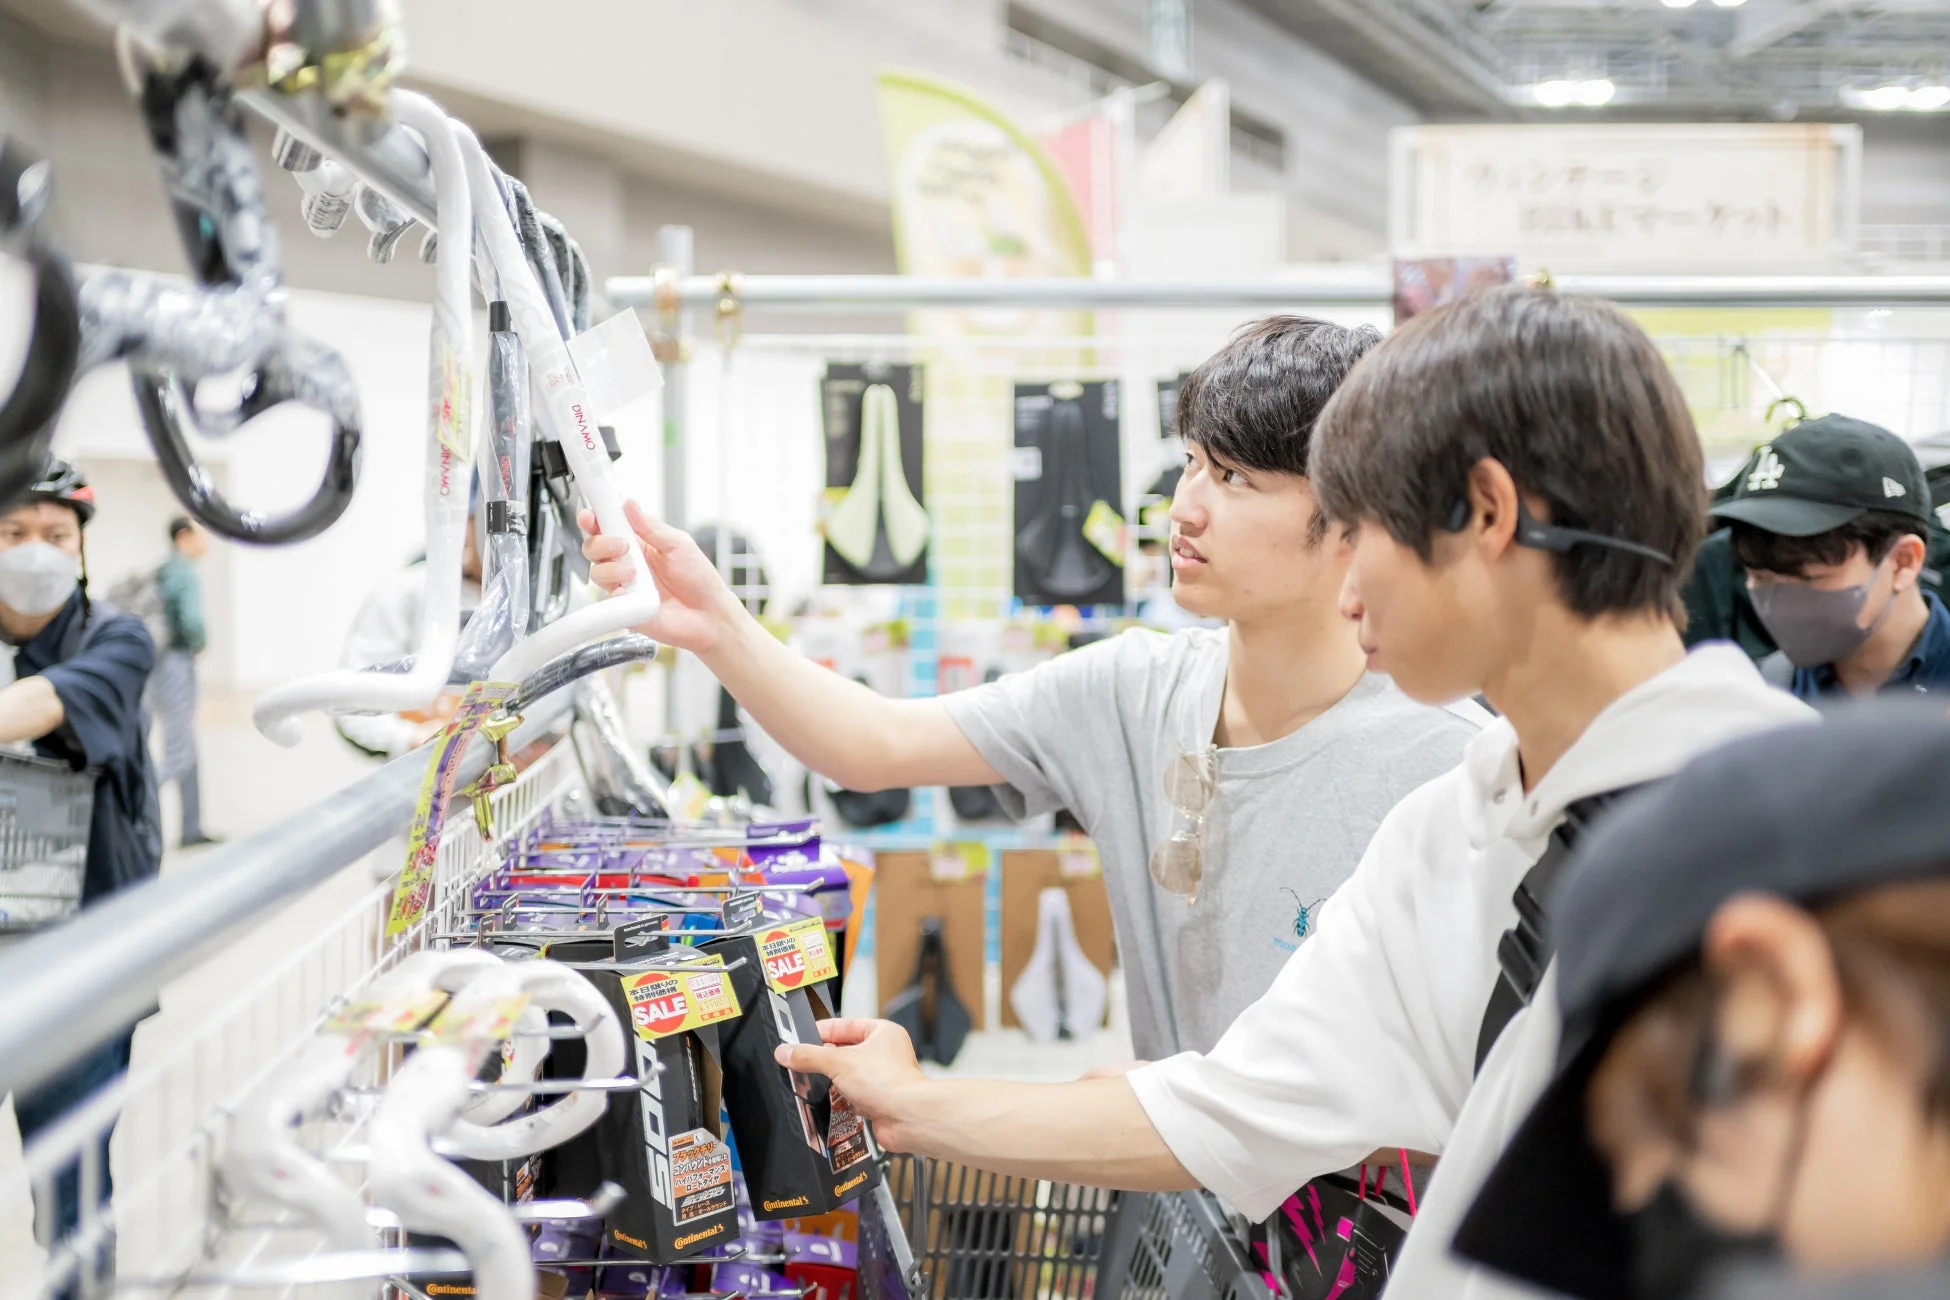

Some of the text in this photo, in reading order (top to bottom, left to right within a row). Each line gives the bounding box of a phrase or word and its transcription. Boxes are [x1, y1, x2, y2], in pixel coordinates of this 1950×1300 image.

[571, 404, 596, 451] DINAMO
[1747, 445, 1785, 491] LA
[767, 953, 806, 979] SALE
[629, 979, 678, 996] 本日限りの
[634, 986, 677, 1003] 特別価格
[633, 995, 689, 1026] SALE
[834, 1174, 863, 1197] Continental
[763, 1196, 802, 1212] Continental
[614, 1229, 643, 1248] Continental
[674, 1224, 718, 1250] Continental
